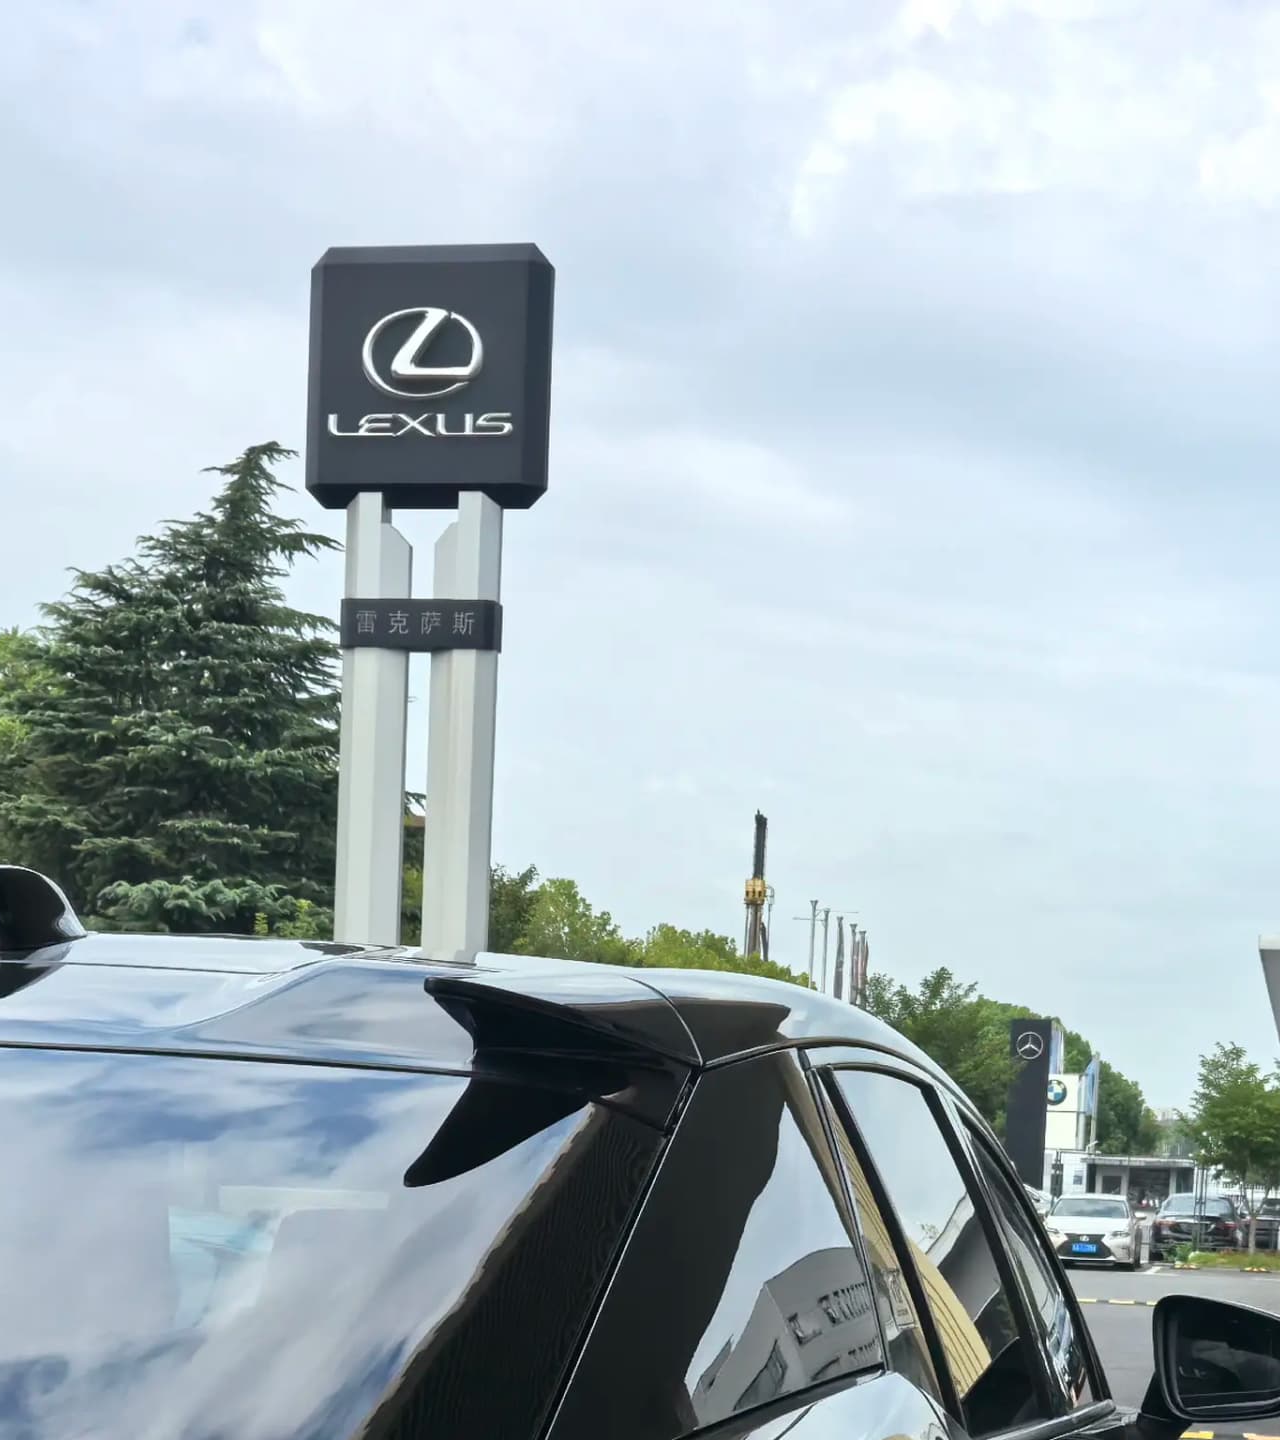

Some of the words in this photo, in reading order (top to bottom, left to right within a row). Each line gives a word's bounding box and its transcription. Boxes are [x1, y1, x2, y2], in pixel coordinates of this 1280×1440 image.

[327, 412, 514, 438] LEXUS
[355, 609, 476, 636] 雷克萨斯
